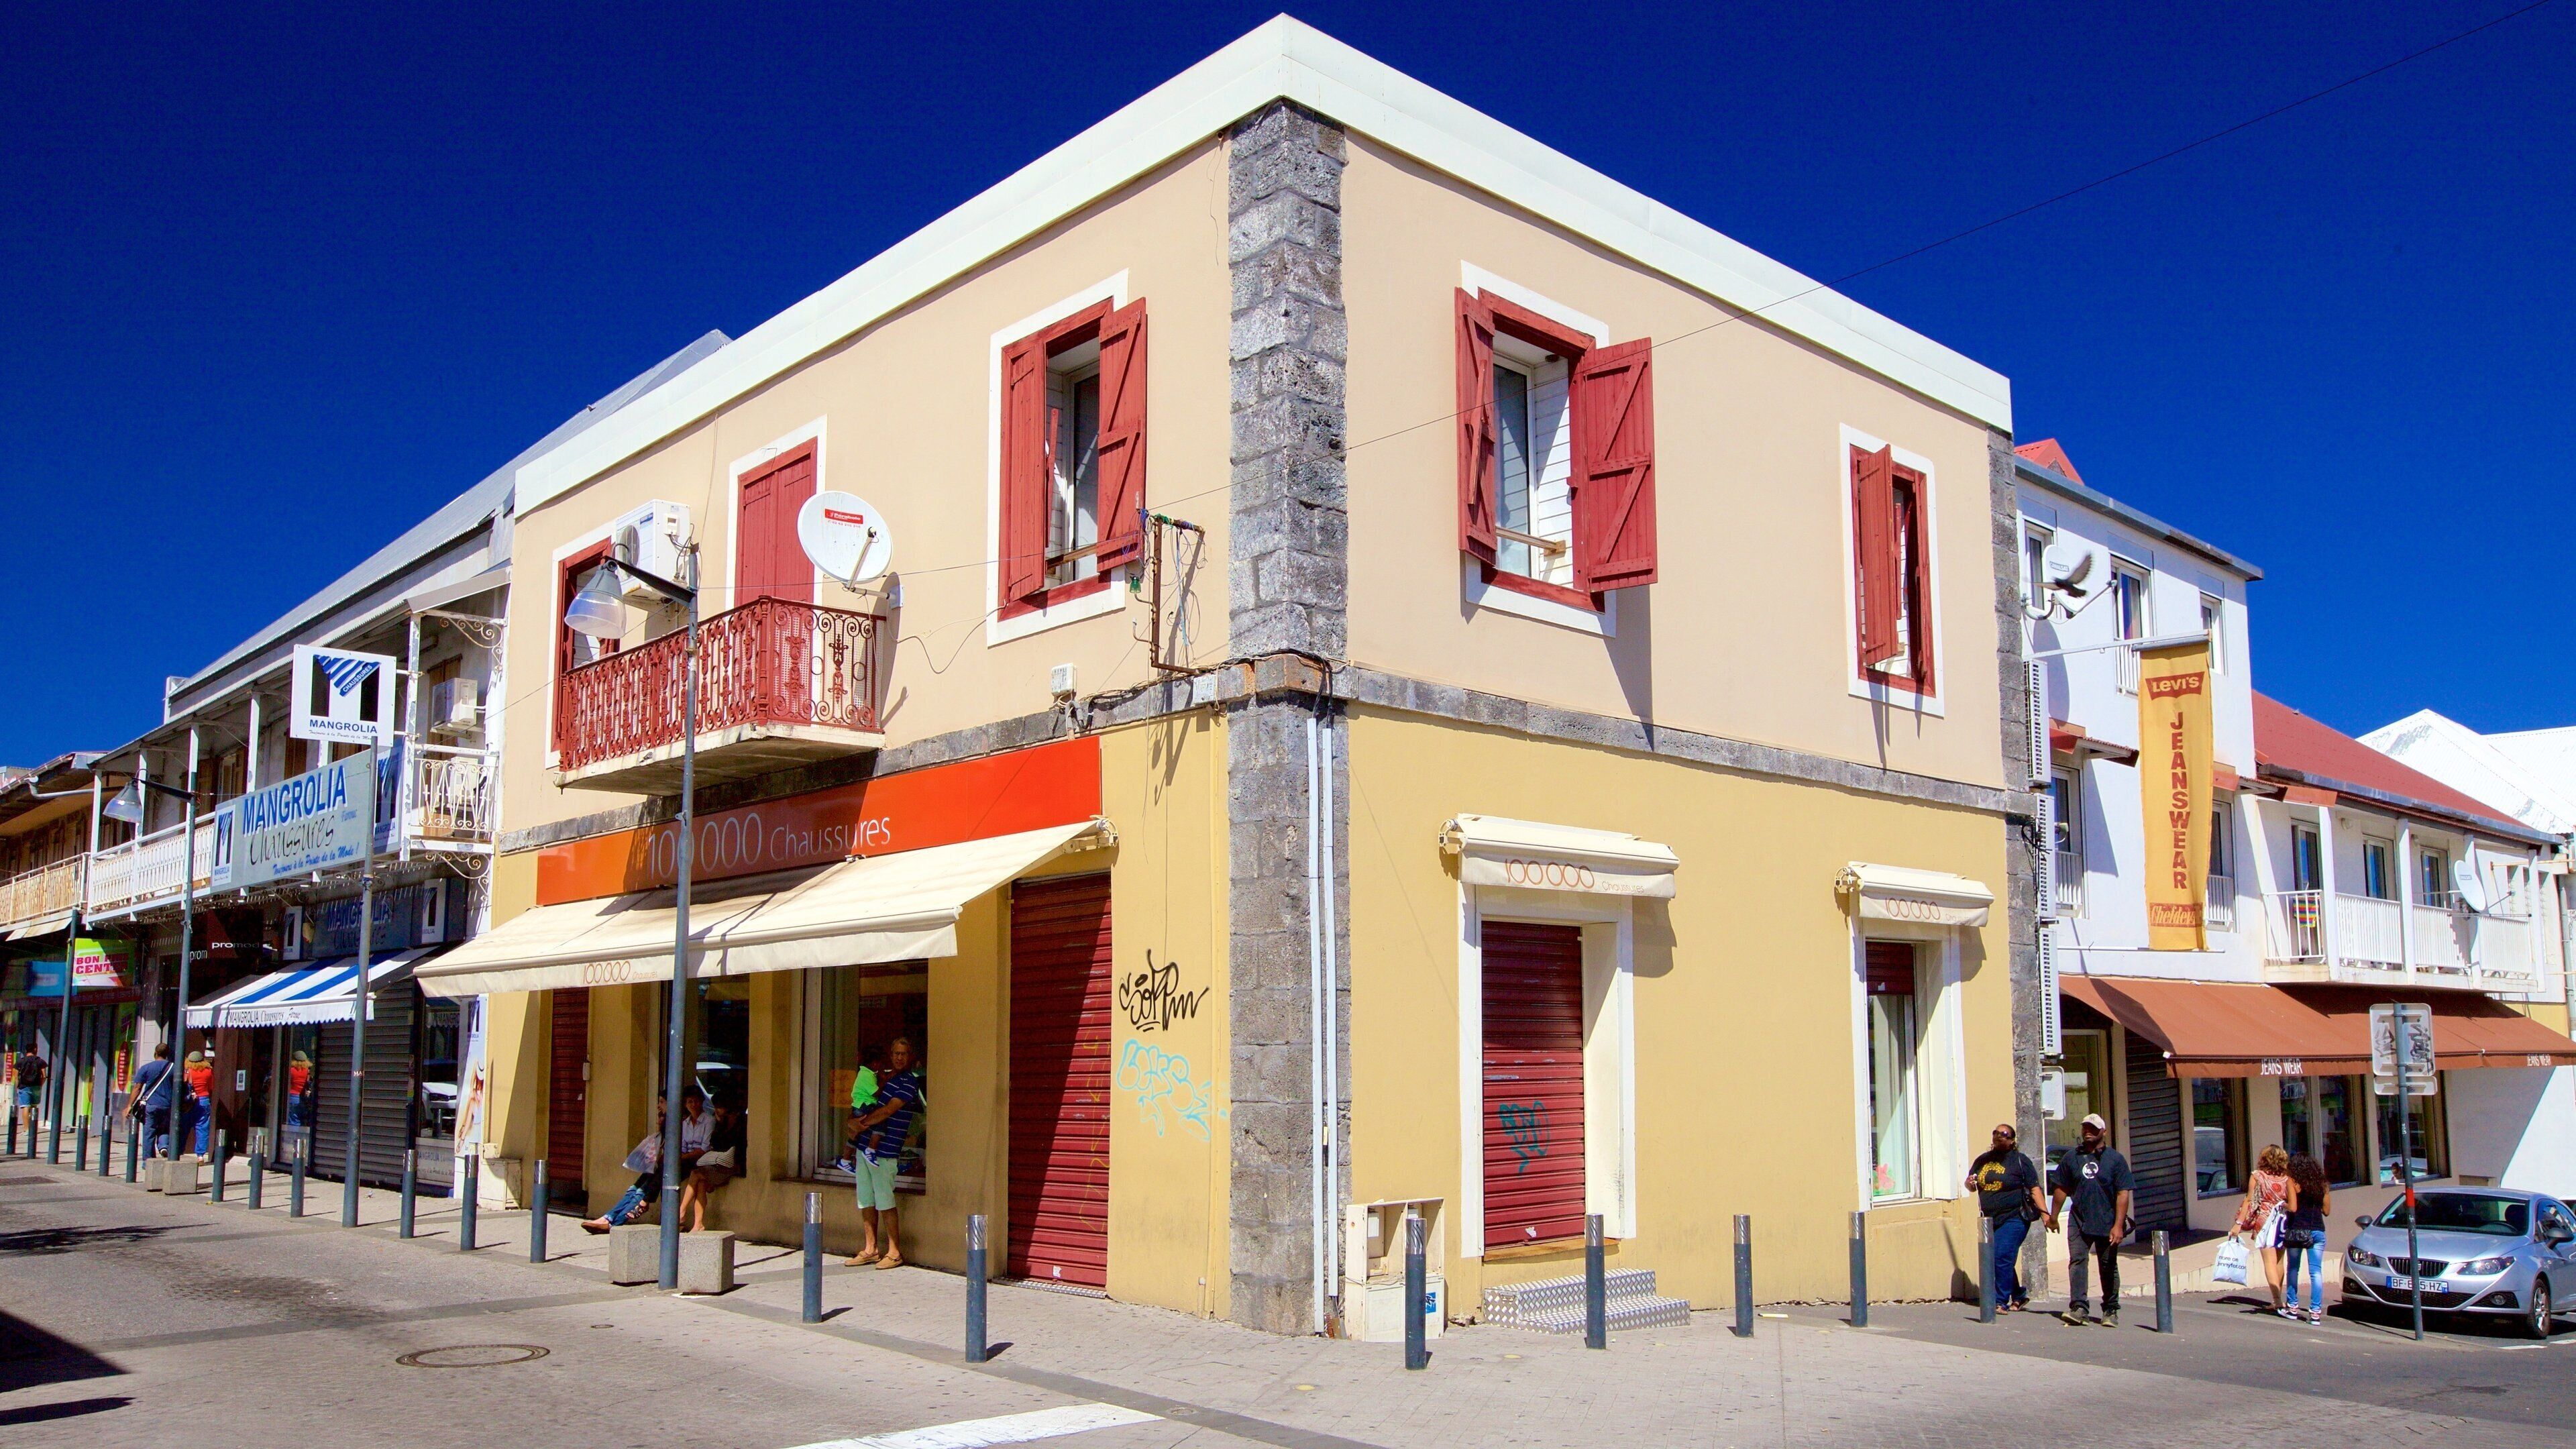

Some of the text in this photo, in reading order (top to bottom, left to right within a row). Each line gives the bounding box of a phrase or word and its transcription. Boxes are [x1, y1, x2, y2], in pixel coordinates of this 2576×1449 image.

[343, 665, 372, 692] CHAUSSURES
[310, 719, 378, 734] MANGROLIA
[242, 765, 347, 838] MANGROLIA
[250, 814, 335, 865] Chaussures
[700, 812, 762, 872] 000
[771, 816, 891, 861] Chaussures
[321, 851, 328, 862] de
[330, 850, 335, 861] la
[337, 845, 354, 858] Mode
[1505, 858, 1645, 894] 100 000 Chaussures
[1885, 897, 1910, 918] 100
[1910, 900, 1941, 920] 000
[211, 942, 260, 950] promod
[76, 955, 100, 965] BON
[603, 960, 631, 982] 000
[2260, 1058, 2303, 1075] JEANS WEAR
